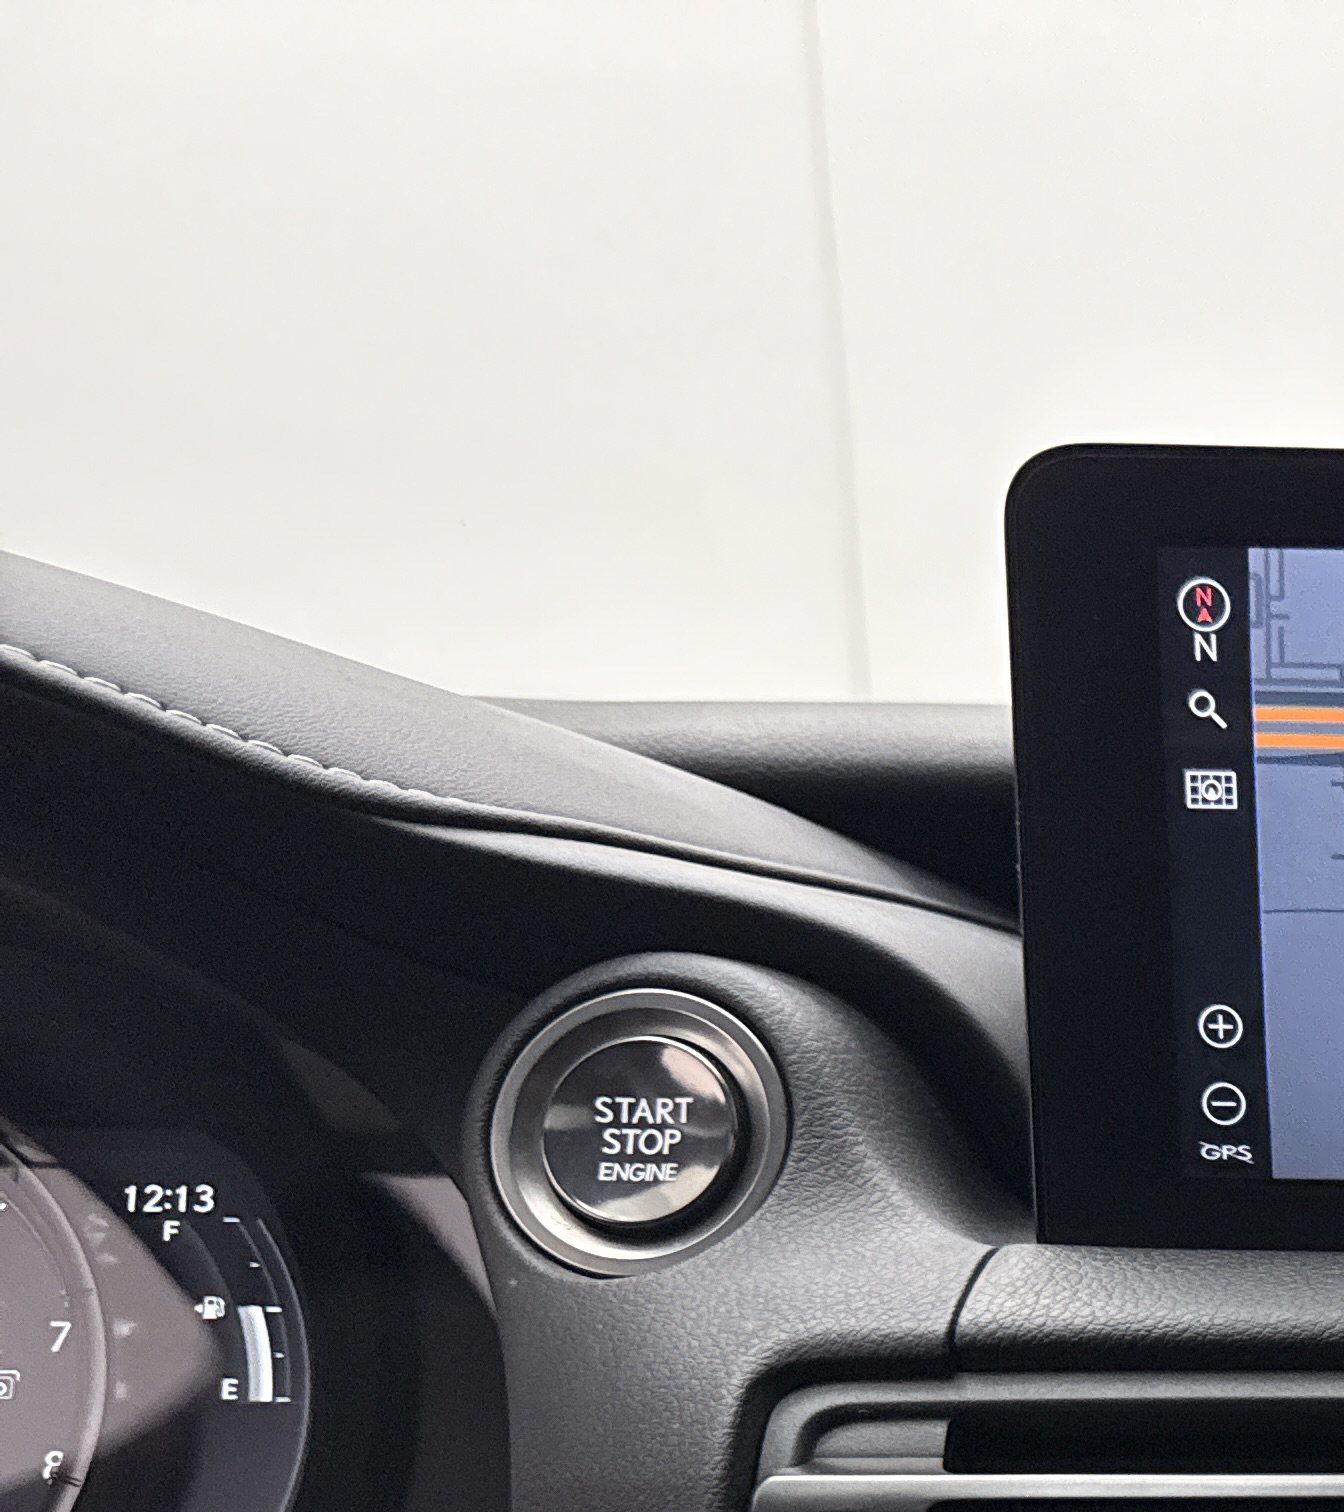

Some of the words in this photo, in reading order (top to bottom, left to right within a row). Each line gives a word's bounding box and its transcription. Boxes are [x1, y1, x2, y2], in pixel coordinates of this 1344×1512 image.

[1194, 633, 1218, 662] N
[594, 1096, 695, 1125] START
[601, 1128, 682, 1156] STOP
[1199, 1142, 1254, 1164] GPS
[597, 1162, 679, 1182] ENGINE
[124, 1183, 215, 1214] 12:13
[162, 1219, 181, 1242] F
[49, 1320, 72, 1353] 7
[220, 1377, 239, 1401] E
